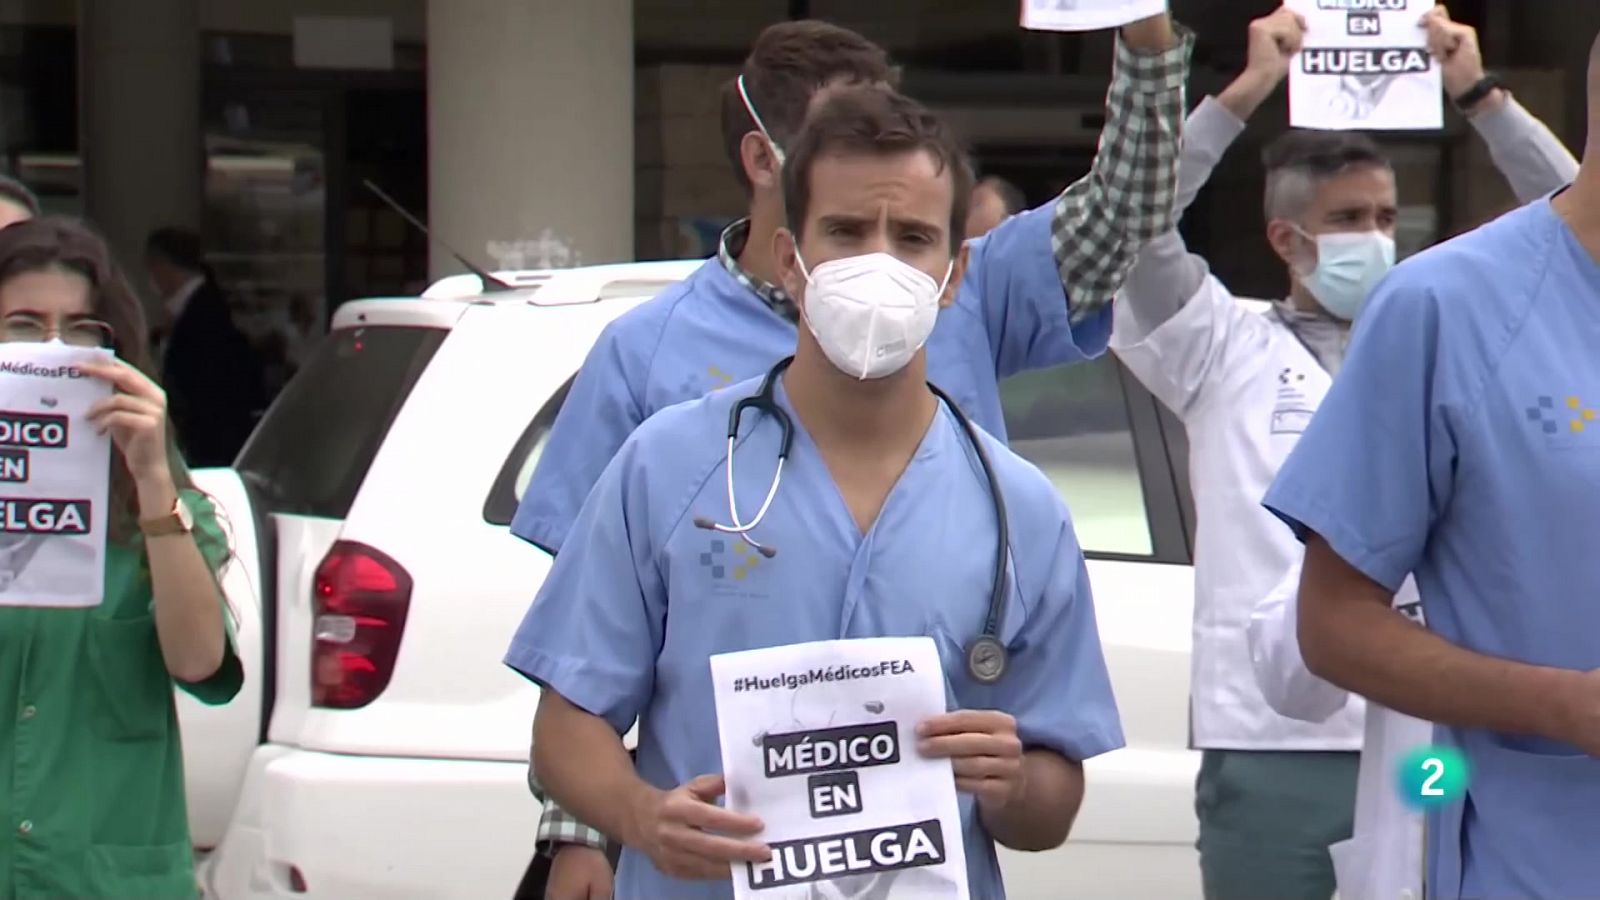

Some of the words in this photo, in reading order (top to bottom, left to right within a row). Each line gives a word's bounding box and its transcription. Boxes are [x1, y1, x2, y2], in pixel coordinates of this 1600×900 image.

[1349, 16, 1378, 32] EN
[1304, 51, 1426, 71] HUELGA
[0, 361, 82, 379] MédicosFE
[734, 659, 914, 692] #HuelgaMédicosFEA
[768, 734, 894, 773] MÉDICO
[813, 784, 858, 813] EN
[752, 828, 940, 884] HUELGA
